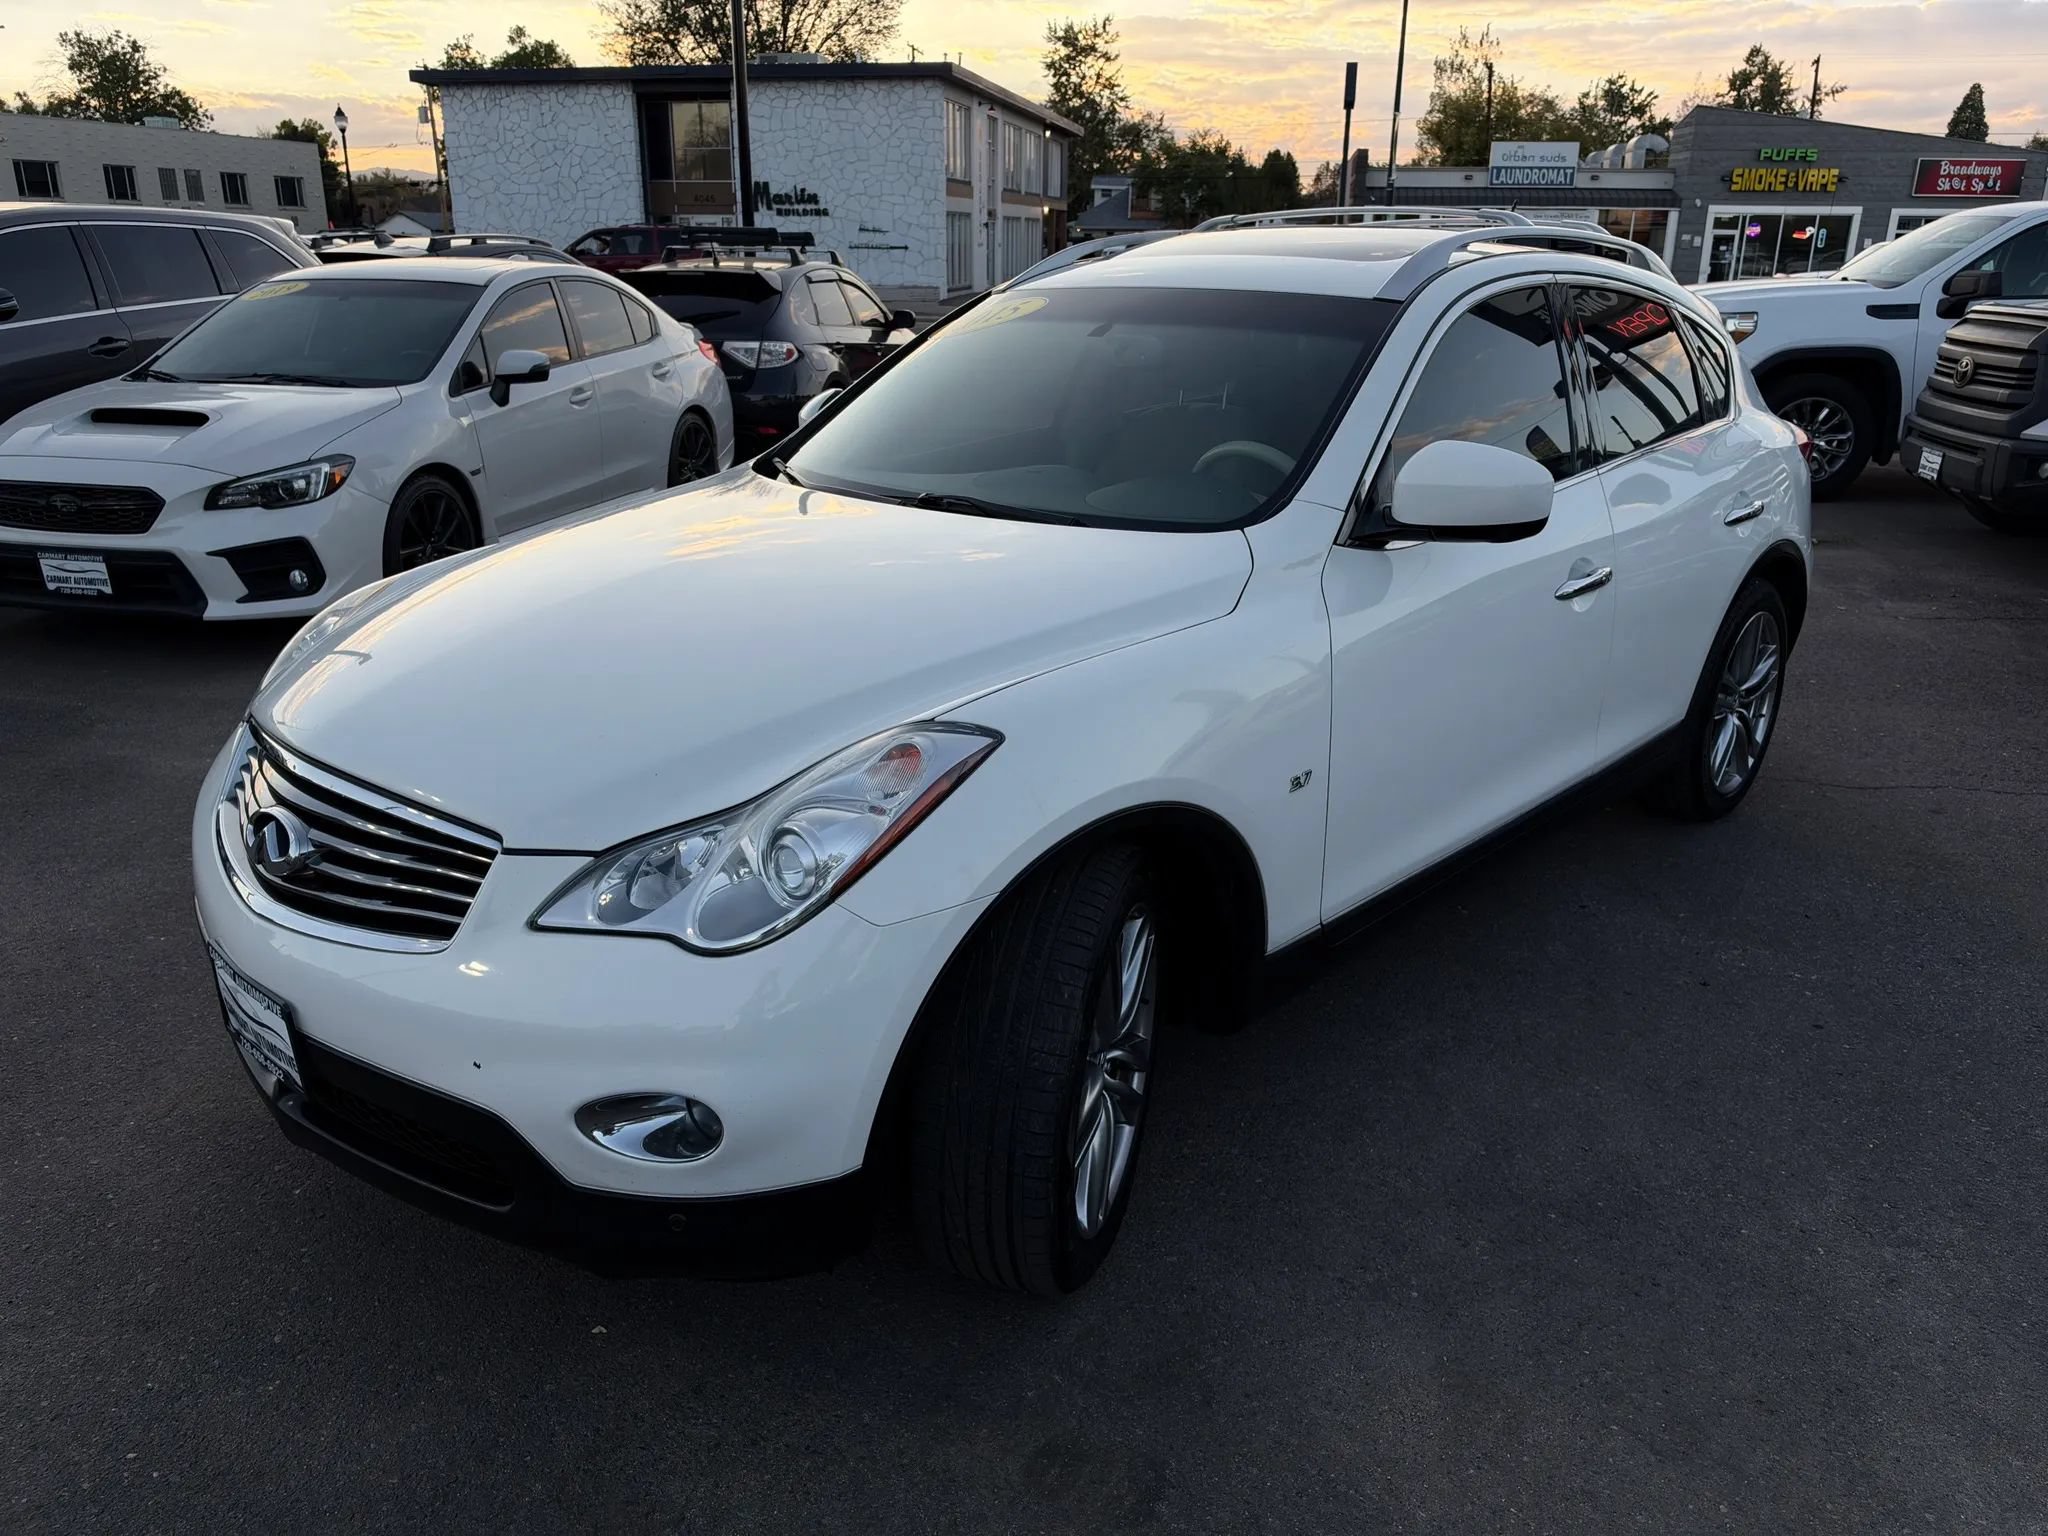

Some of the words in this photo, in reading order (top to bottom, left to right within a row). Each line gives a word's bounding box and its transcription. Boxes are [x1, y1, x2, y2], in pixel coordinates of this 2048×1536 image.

[1539, 152, 1567, 163] suds
[1760, 148, 1818, 161] PUFFS
[1492, 168, 1573, 185] LAUNDROMAT
[1940, 161, 2002, 178] Broadways
[1731, 168, 1787, 191] SMOKE
[1787, 171, 1796, 188] &
[1797, 168, 1839, 191] VAPE
[753, 181, 820, 212] Marlin
[776, 208, 829, 216] BUILDING
[37, 552, 65, 560] CARMART
[67, 554, 103, 562] AUTOMOTIVE
[46, 574, 72, 585] CARMART
[73, 576, 109, 588] AUTOMOTIVE
[235, 974, 283, 1018] AUTOMOTIVE
